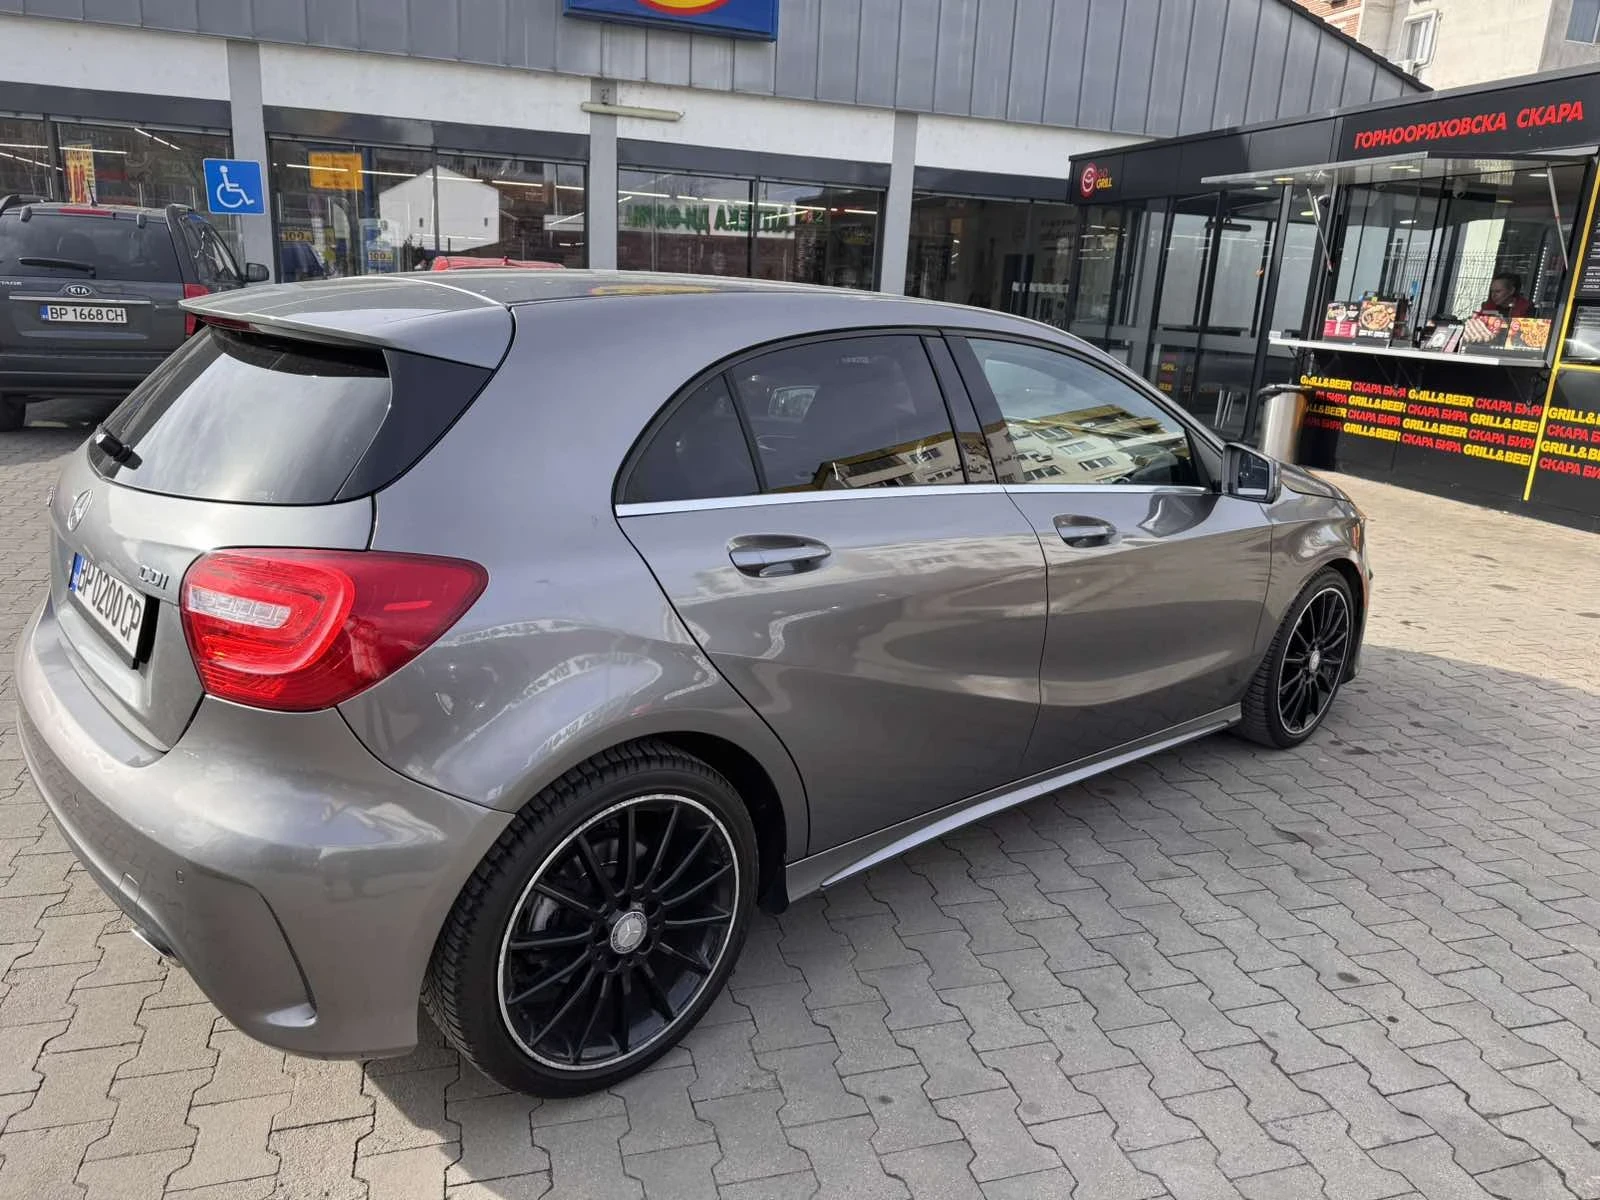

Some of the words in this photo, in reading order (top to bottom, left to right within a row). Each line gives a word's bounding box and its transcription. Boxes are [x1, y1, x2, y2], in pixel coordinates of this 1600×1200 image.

[1354, 111, 1508, 149] ГОРНООРЯХОВСКА
[1516, 100, 1584, 128] СКАРА
[70, 287, 88, 295] KIA
[50, 307, 68, 320] BP
[72, 308, 104, 320] 1668
[106, 309, 125, 321] CH
[1353, 382, 1381, 395] СКАРА
[1475, 398, 1513, 413] СКАРА
[1347, 409, 1377, 423] СКАРА
[1377, 413, 1401, 427] БИРА
[1402, 417, 1468, 439] GRILL&BEER
[1468, 428, 1505, 446] СКАРА
[1408, 403, 1440, 419] СКАРА
[1441, 408, 1468, 423] БИРА
[1546, 423, 1589, 442] СКАРА
[1402, 432, 1434, 449] СКАРА
[1435, 439, 1462, 454] БИРА
[1539, 456, 1581, 476] СКАРА
[139, 565, 170, 591] CDI
[91, 567, 124, 628] 0200
[120, 593, 142, 641] CP
